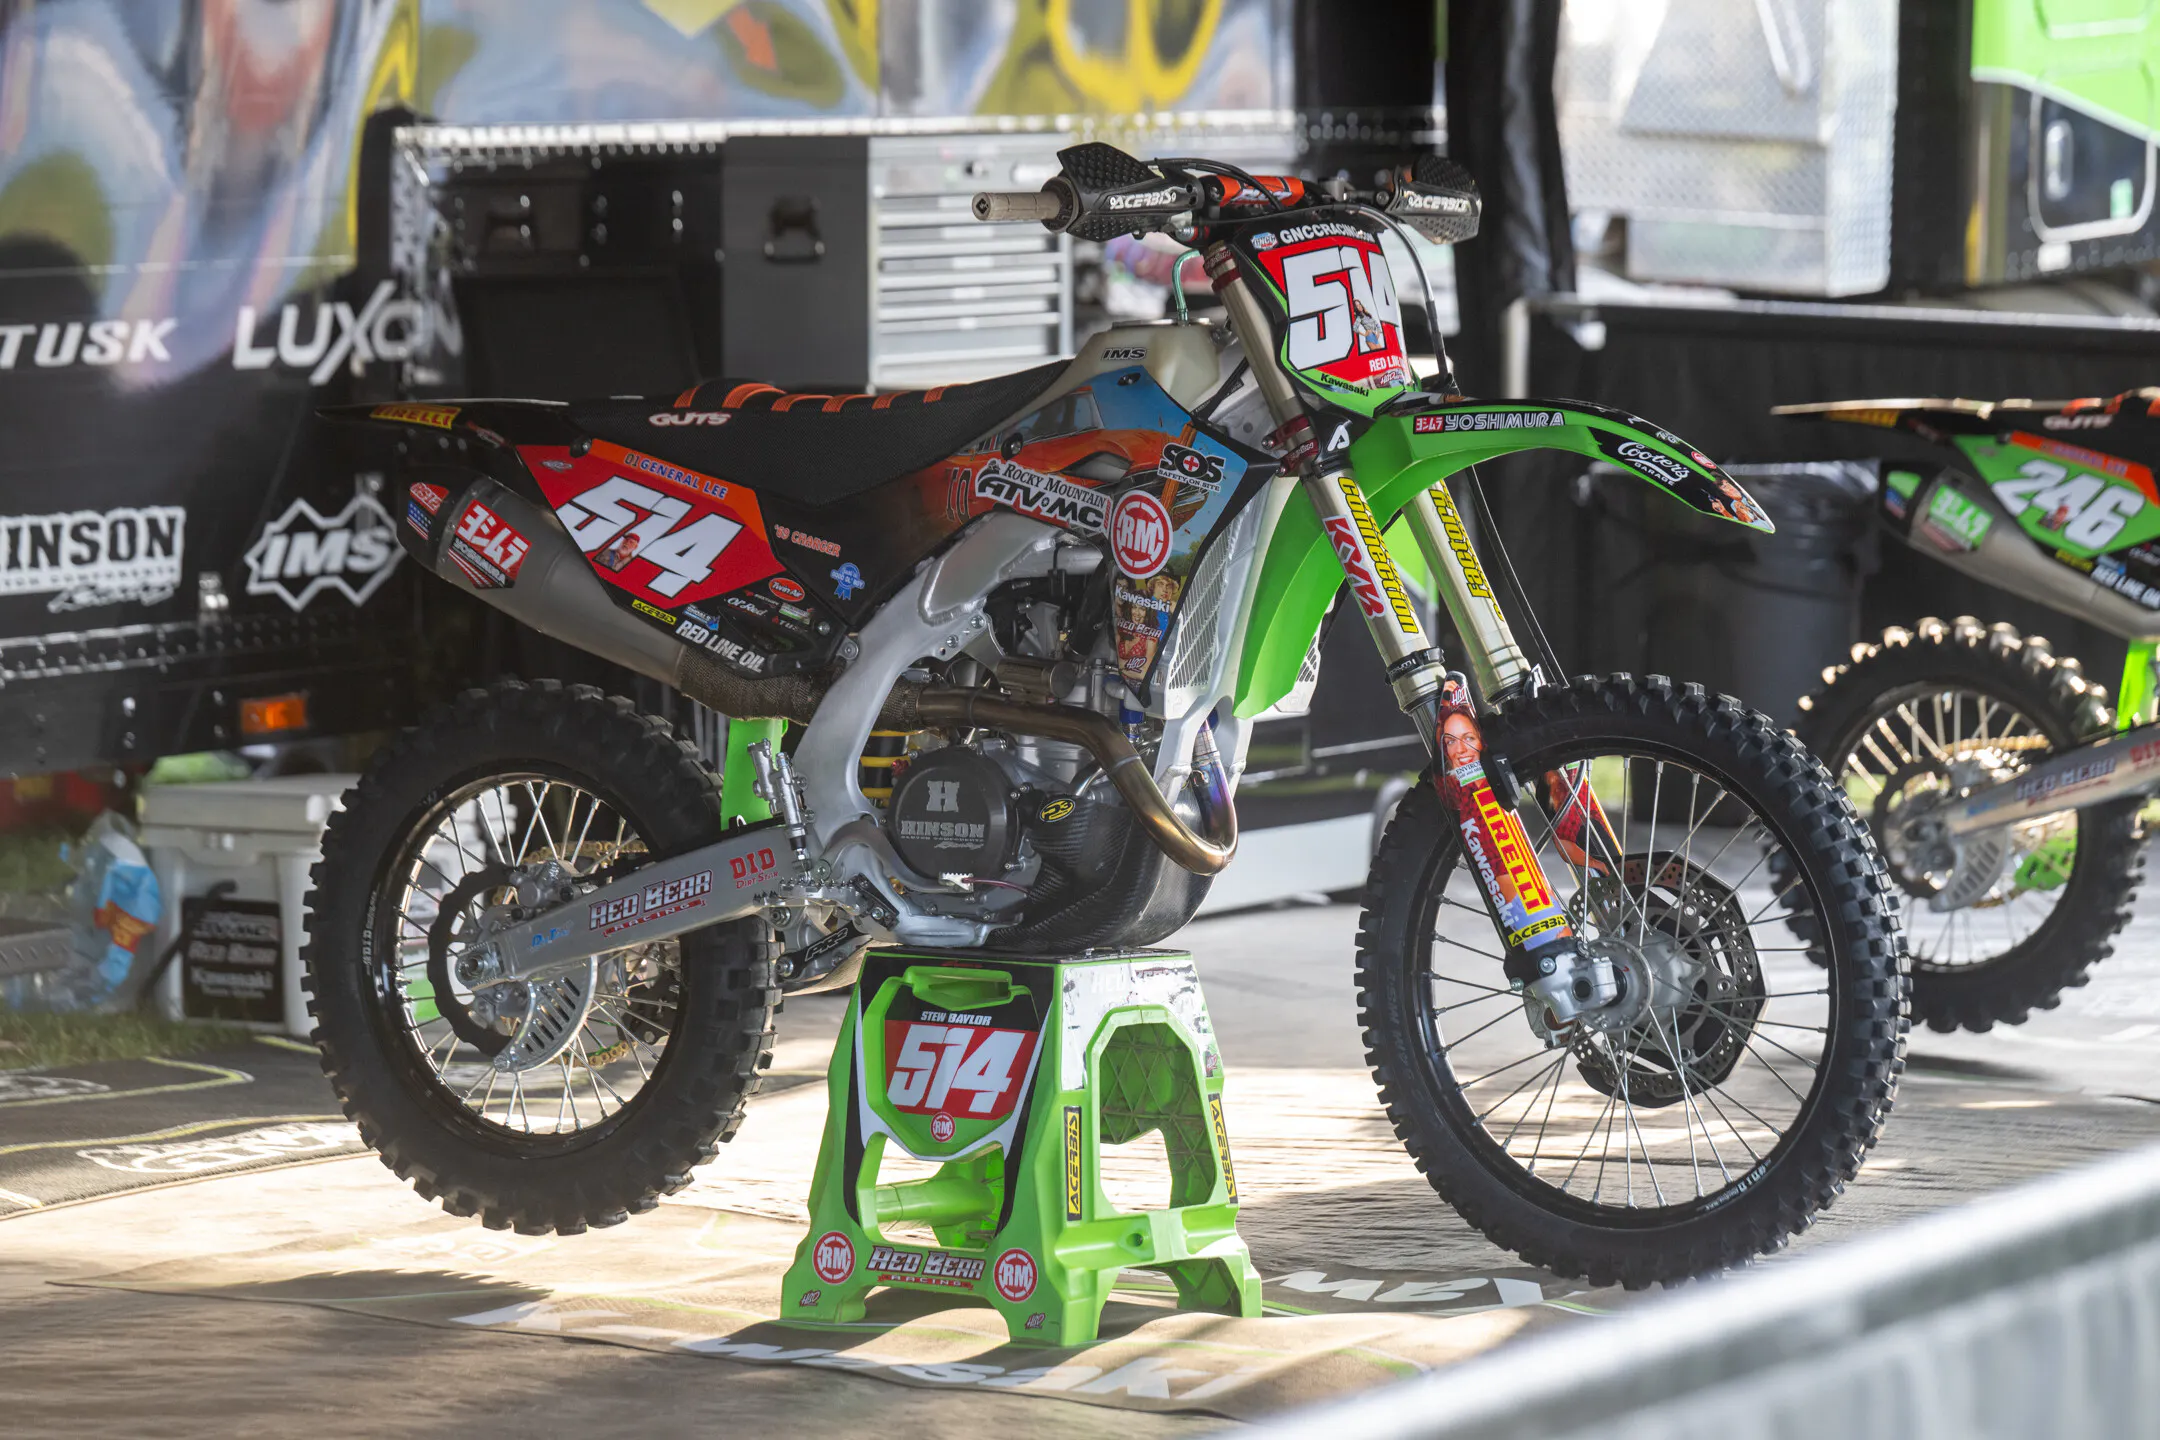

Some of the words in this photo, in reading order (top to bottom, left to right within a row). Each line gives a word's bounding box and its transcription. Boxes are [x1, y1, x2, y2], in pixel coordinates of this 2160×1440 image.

[1112, 190, 1174, 210] ACERBIS
[1282, 246, 1400, 369] 514
[0, 317, 178, 369] TUSK
[233, 280, 463, 386] LUXON
[1102, 347, 1148, 360] IMS
[1369, 356, 1387, 372] RED
[1320, 373, 1369, 397] Kawasaki
[648, 411, 732, 428] GUTS
[1445, 411, 1565, 431] YOSHIMURA
[1160, 442, 1227, 484] SOS
[1617, 441, 1691, 482] Cooter's
[1634, 461, 1676, 487] GARAGE
[640, 459, 700, 489] GENERAL
[702, 480, 729, 500] LEE
[1002, 463, 1042, 487] ROCKY
[1044, 477, 1107, 508] MOUNTAIN
[1158, 469, 1187, 484] SAFETY
[1188, 477, 1202, 488] ON
[1202, 481, 1221, 493] SITE
[1992, 458, 2146, 550] 246
[0, 515, 176, 571] INSON
[261, 528, 397, 579] IMS
[556, 475, 744, 599] 514
[791, 531, 841, 557] CHARGER
[1322, 515, 1386, 620] KYB
[789, 588, 803, 598] Air
[1115, 585, 1170, 613] Kawasaki
[633, 601, 676, 624] ACERBIS
[675, 620, 710, 644] RED
[704, 634, 744, 661] LINE
[738, 651, 766, 674] OIL
[1456, 760, 1481, 776] ENVIRO
[901, 820, 985, 838] HINSON
[729, 848, 776, 880] DID
[1476, 787, 1551, 910] PIRELLI
[1460, 817, 1521, 928] Kawasaki
[589, 894, 640, 931] RED
[643, 870, 713, 912] BEAR
[613, 902, 690, 931] RACING
[1511, 915, 1567, 947] ACERBIS
[920, 1010, 946, 1022] STEW
[948, 1012, 993, 1027] BAYLOR
[886, 1023, 1027, 1114] 514
[1068, 1113, 1081, 1212] ACERBIS
[1210, 1103, 1234, 1197] ACERBIS
[866, 1247, 923, 1274] RED
[922, 1251, 988, 1281] BEAR
[890, 1274, 963, 1287] RACING
